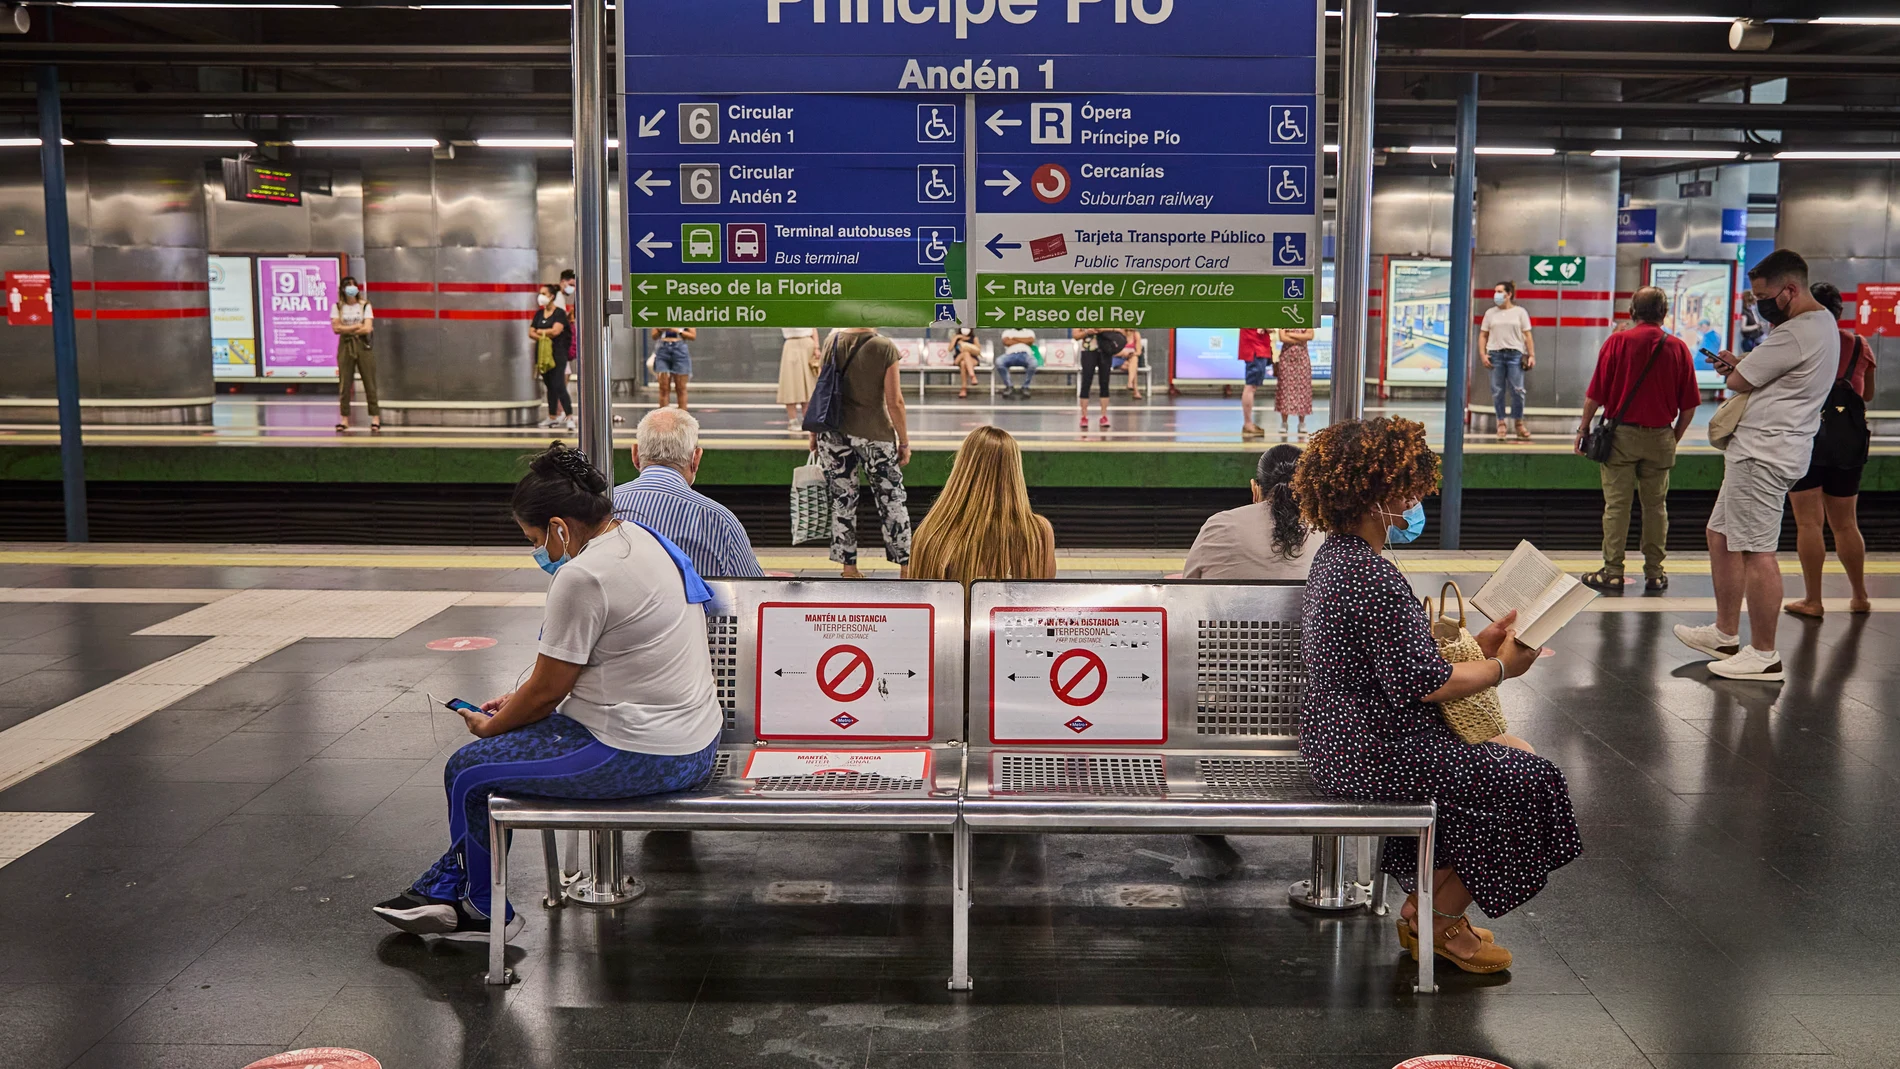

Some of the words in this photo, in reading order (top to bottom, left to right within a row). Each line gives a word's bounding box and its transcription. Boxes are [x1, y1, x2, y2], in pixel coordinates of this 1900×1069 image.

[898, 59, 1018, 89] Andén
[1039, 60, 1053, 89] 1
[729, 105, 793, 119] Circular
[1081, 101, 1131, 122] Ópera
[689, 108, 711, 139] 6
[1039, 108, 1064, 138] R
[729, 129, 781, 143] Andén
[788, 130, 793, 143] 1
[1082, 130, 1148, 147] Príncipe
[1155, 130, 1180, 144] Pío
[730, 165, 794, 179] Circular
[1081, 163, 1164, 178] Cercanías
[691, 169, 712, 199] 6
[730, 189, 781, 203] Andén
[787, 190, 796, 203] 2
[1080, 191, 1154, 205] Suburban
[1160, 192, 1213, 209] railway
[775, 225, 833, 237] Terminal
[838, 225, 911, 237] autobuses
[1075, 230, 1123, 245] Tarjeta
[1128, 230, 1206, 246] Transporte
[1211, 230, 1265, 243] Público
[775, 252, 800, 264] Bus
[806, 252, 859, 264] terminal
[1075, 255, 1119, 268] Public
[1125, 255, 1191, 271] Transport
[1195, 256, 1229, 268] Card
[280, 273, 295, 293] 9
[667, 280, 721, 295] Paseo
[728, 280, 750, 294] de
[757, 279, 772, 294] la
[779, 279, 841, 294] Florida
[1014, 280, 1055, 295] Ruta
[1062, 280, 1114, 295] Verde
[1120, 280, 1126, 297] /
[1132, 280, 1184, 295] Green
[1190, 282, 1234, 295] route
[272, 296, 312, 311] PARA
[314, 296, 328, 311] TI
[667, 307, 729, 321] Madrid
[737, 305, 766, 321] Río
[1014, 306, 1070, 321] Paseo
[1076, 307, 1103, 321] del
[1111, 307, 1145, 325] Rey
[805, 612, 836, 622] MANTÉN
[814, 624, 878, 632] INTERPERSONAL
